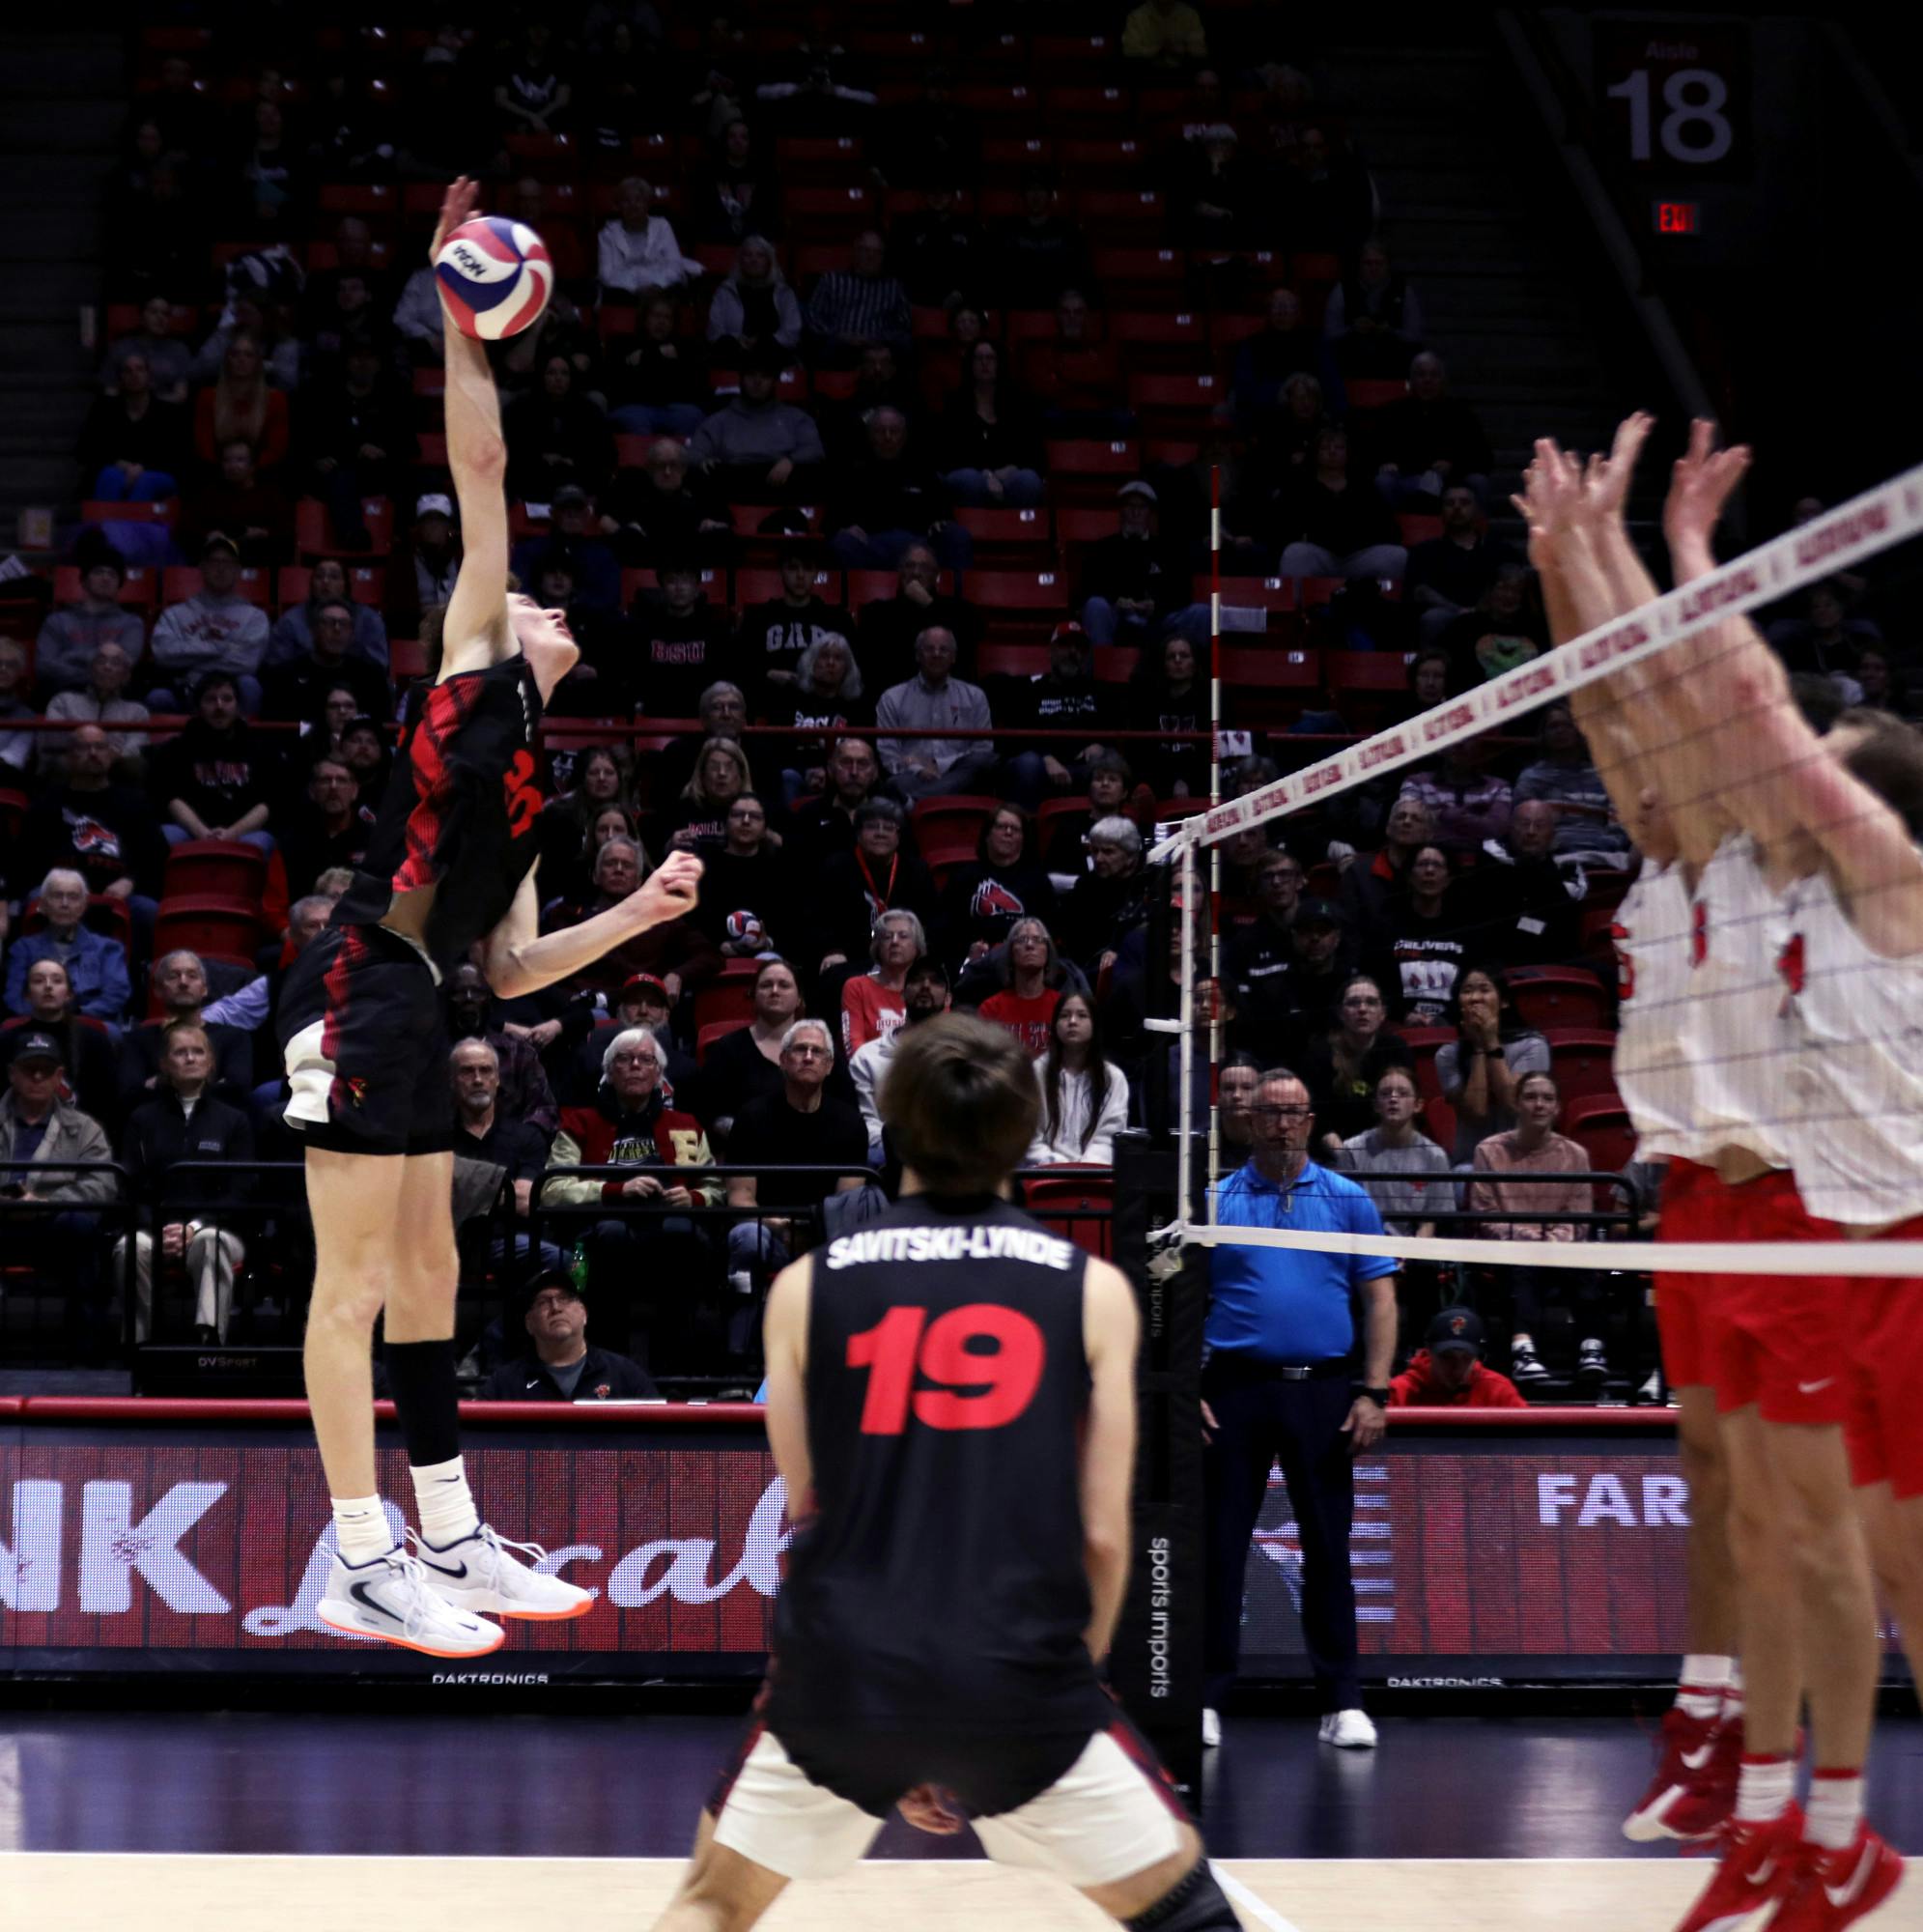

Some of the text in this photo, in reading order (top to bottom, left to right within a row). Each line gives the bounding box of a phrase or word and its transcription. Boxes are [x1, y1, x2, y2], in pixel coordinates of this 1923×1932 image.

[1644, 40, 1700, 62] Aisle
[1606, 66, 1735, 165] 18
[827, 1225, 1074, 1270] SAVITSKI-LYNDE
[844, 1302, 1047, 1435] 19
[1145, 1537, 1173, 1698] sports imports
[432, 1672, 550, 1686] DAKTRONICS
[1387, 1677, 1505, 1689] DAKTRONICS
